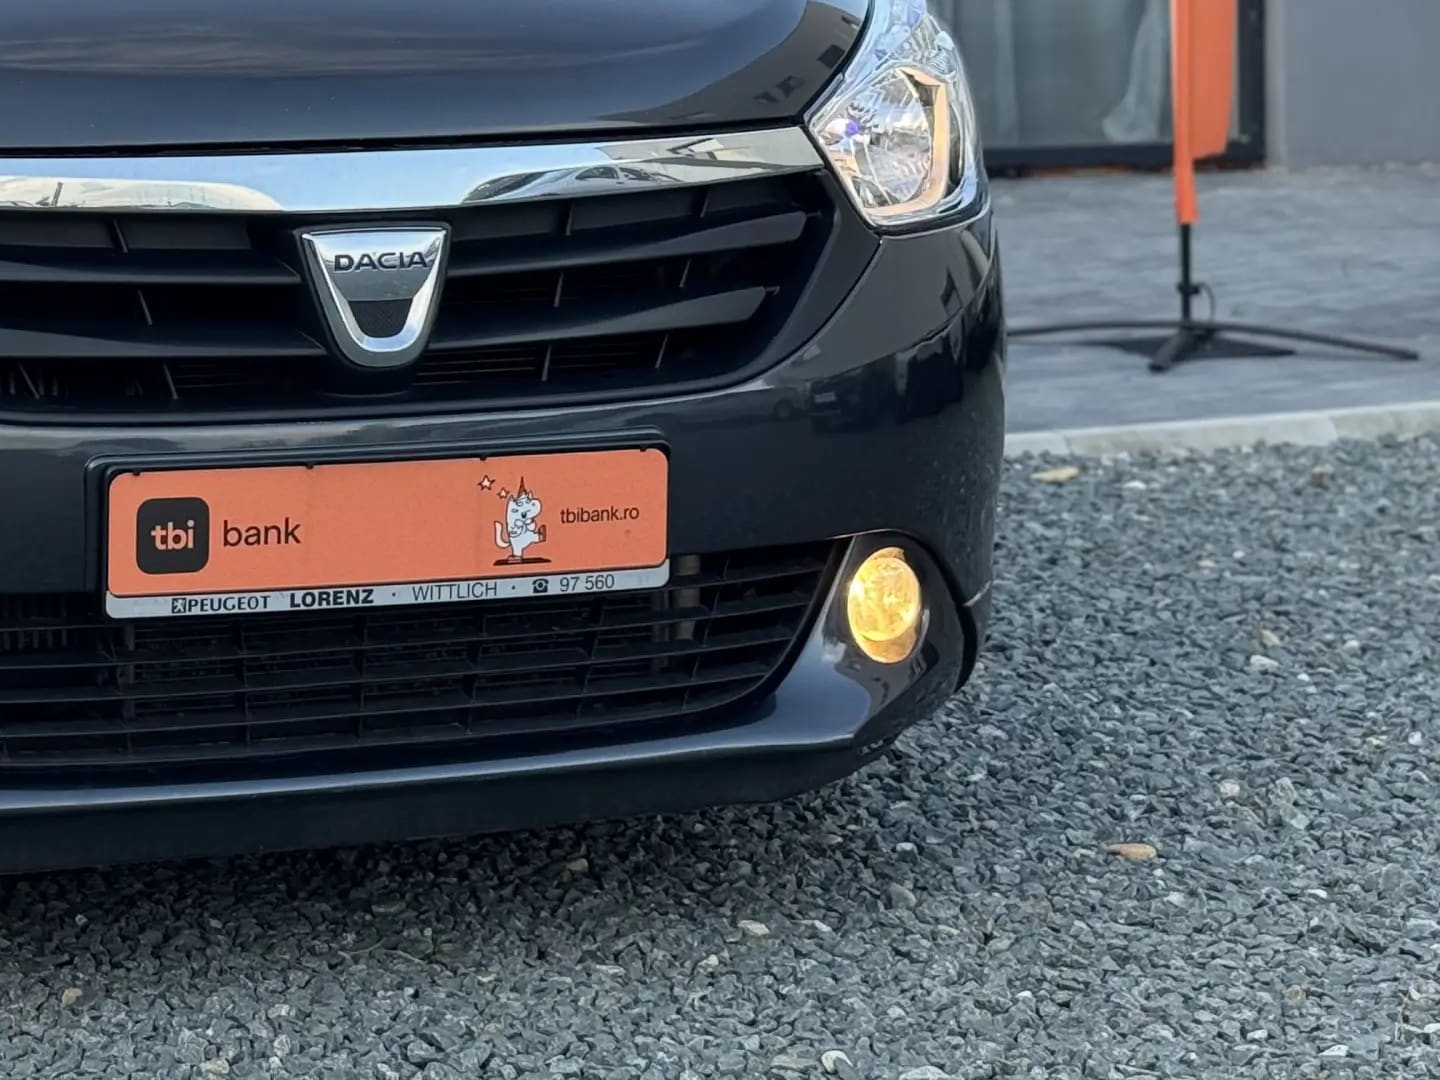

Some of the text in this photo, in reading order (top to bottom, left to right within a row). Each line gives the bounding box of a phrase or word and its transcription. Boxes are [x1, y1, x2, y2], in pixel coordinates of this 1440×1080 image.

[333, 251, 428, 273] DACIA
[560, 505, 640, 524] tbibank.ro
[150, 516, 302, 552] tbi bank
[187, 573, 616, 612] PEUGEOT LORENZ WITTLICH 97 560
